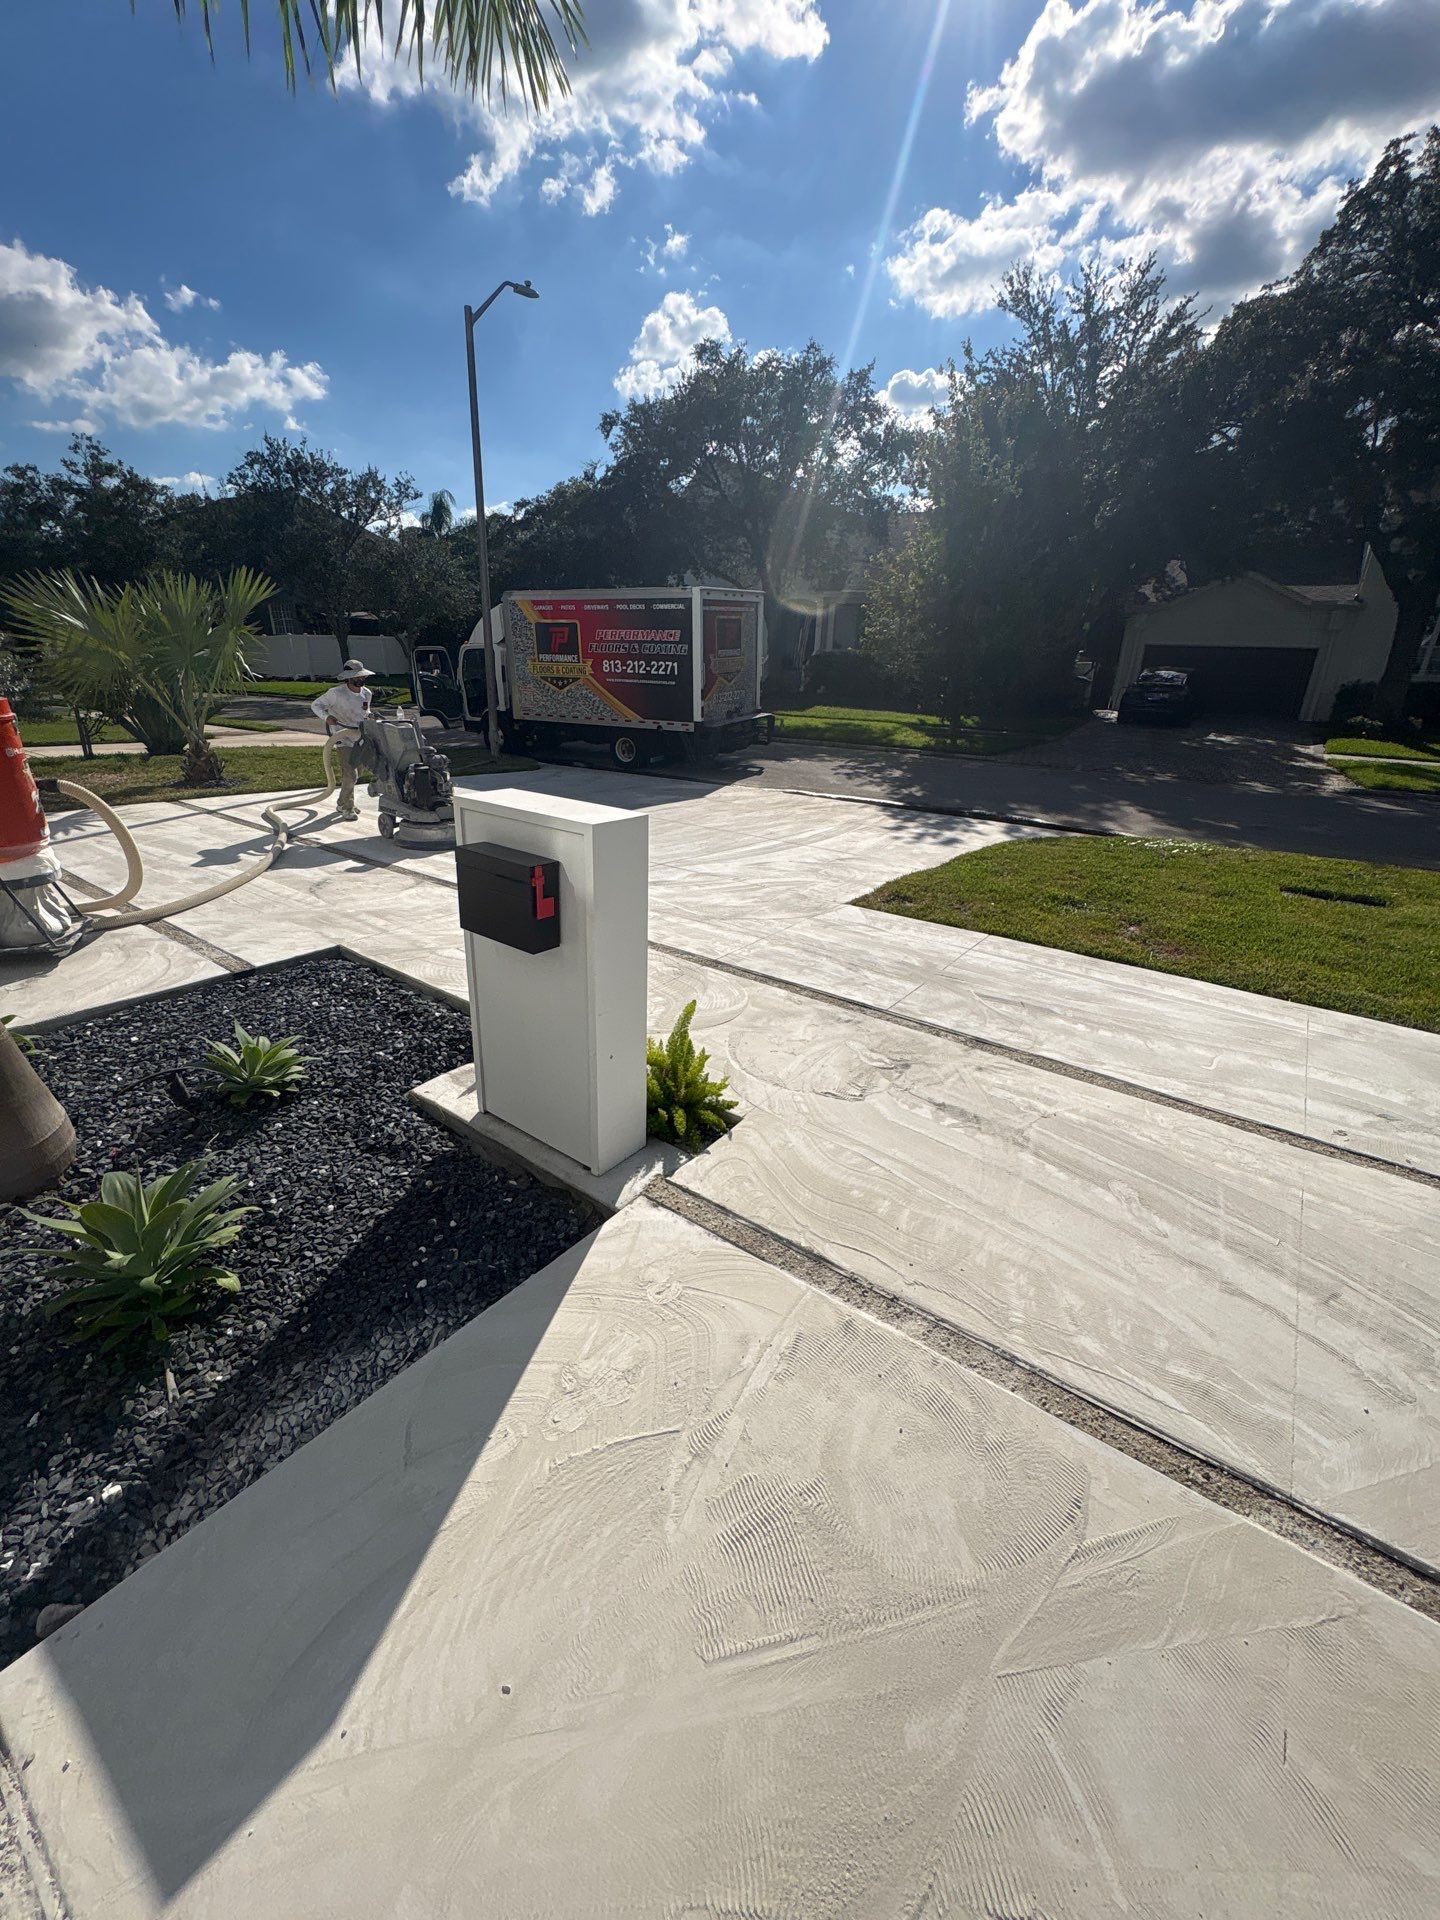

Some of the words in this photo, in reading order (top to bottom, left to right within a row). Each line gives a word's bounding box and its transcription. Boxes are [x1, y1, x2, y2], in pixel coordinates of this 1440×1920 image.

[594, 629, 681, 641] PERFORMANCE
[588, 642, 628, 654] FLOORS
[630, 643, 639, 654] &
[641, 643, 688, 656] COATING
[539, 653, 579, 662] PERFORMANCE
[532, 664, 555, 676] FLOORS
[561, 665, 587, 676] COATING
[602, 659, 678, 675] 813-212-2271
